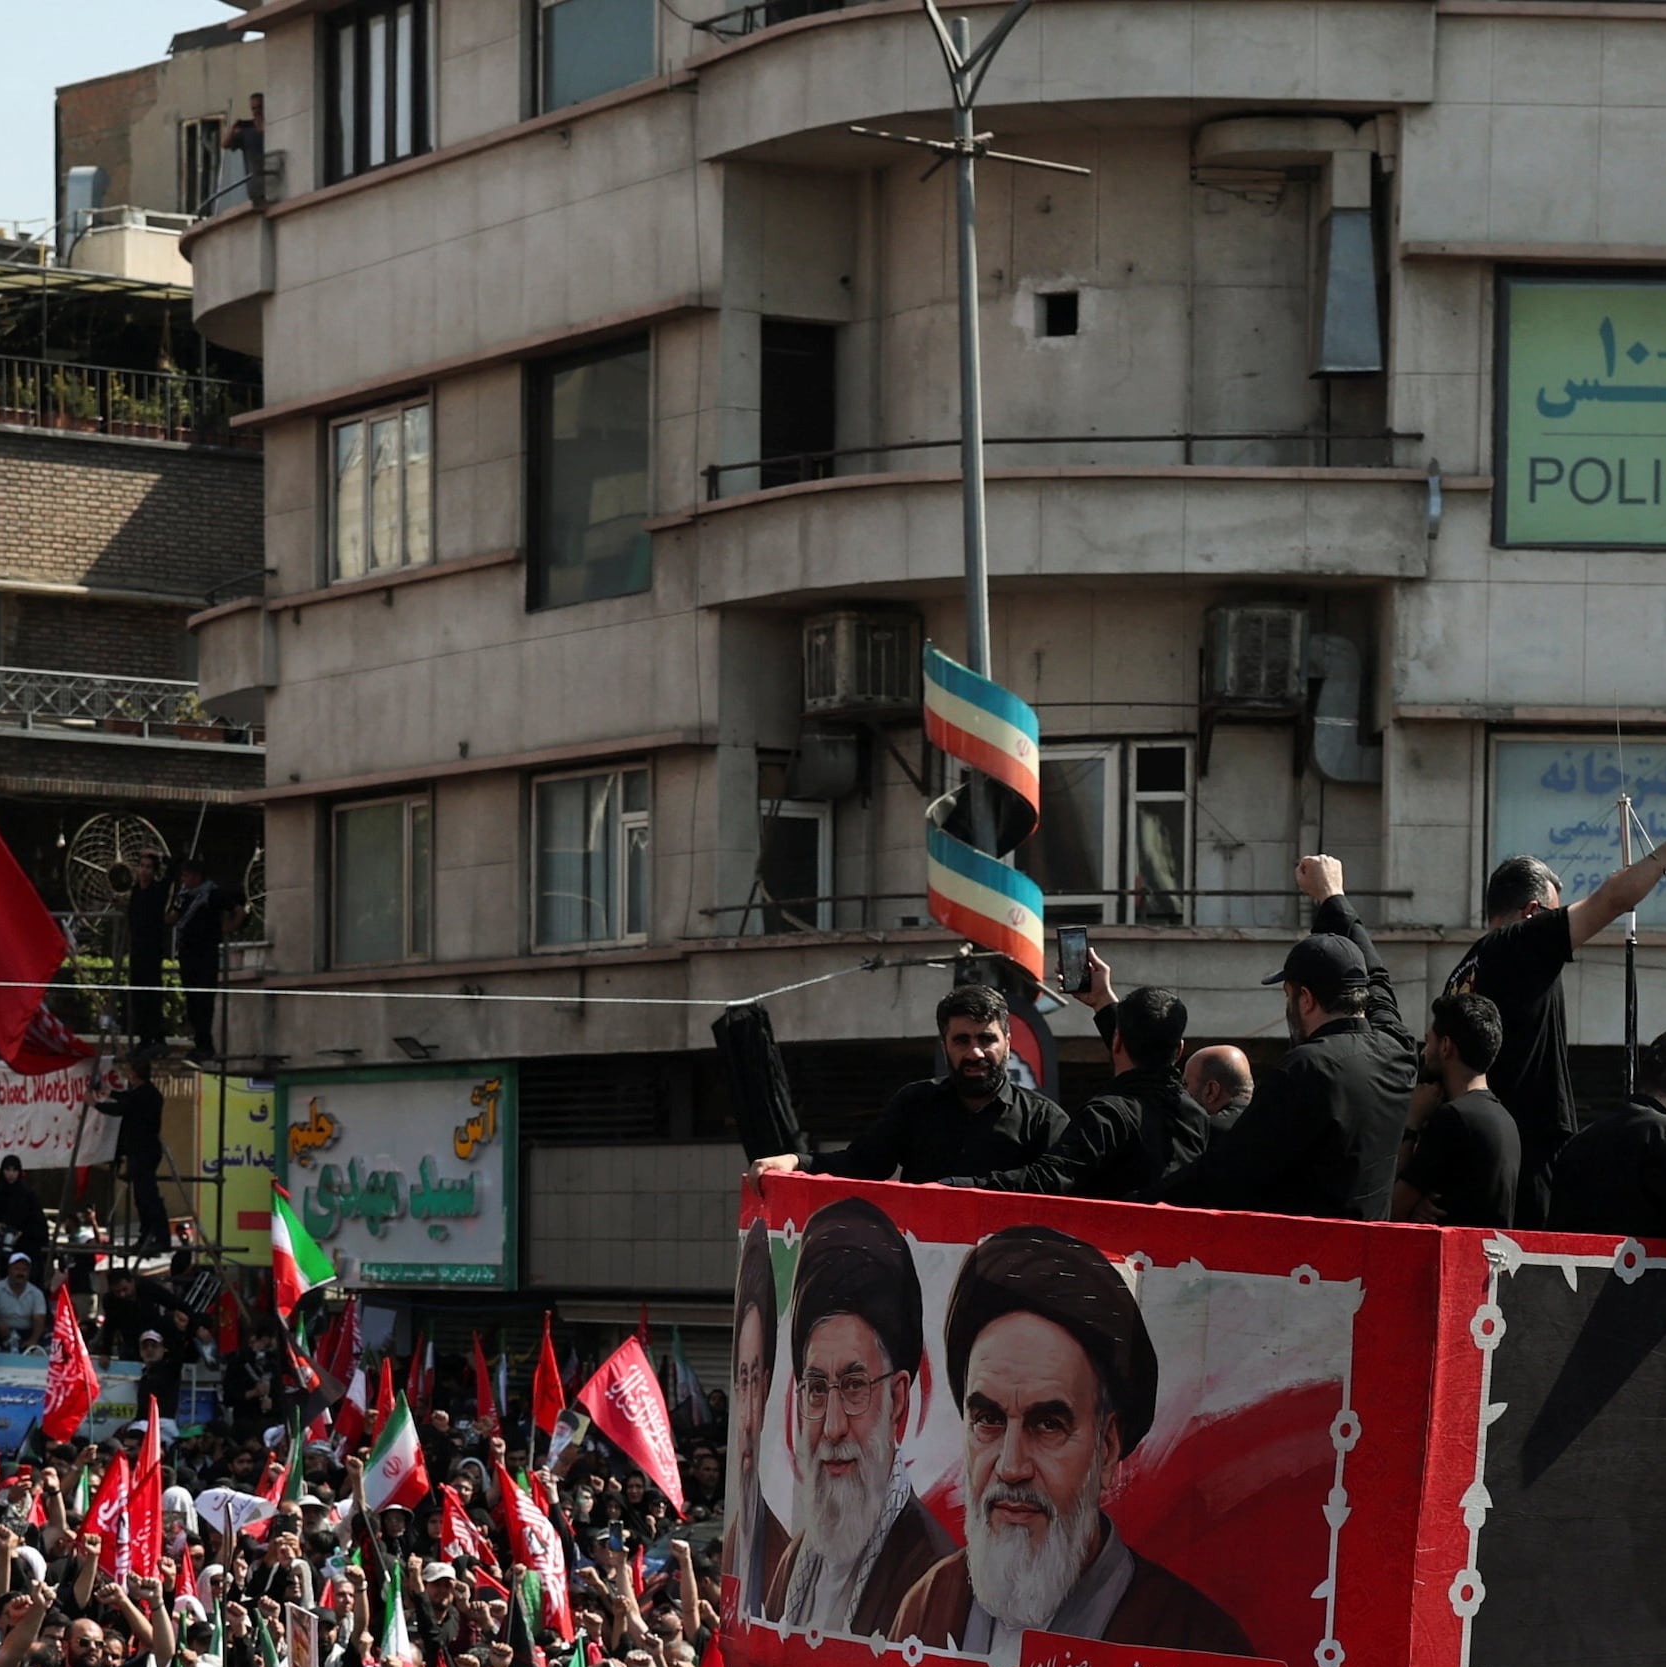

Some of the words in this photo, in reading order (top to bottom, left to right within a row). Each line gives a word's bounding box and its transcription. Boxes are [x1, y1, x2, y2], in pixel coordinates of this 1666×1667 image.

[1548, 818, 1623, 846] رسمی
[288, 1096, 338, 1168] حلیم
[454, 1078, 501, 1160] آش
[202, 1145, 275, 1173] هداشتی
[304, 1154, 403, 1240] مهدی
[410, 1154, 480, 1241] سید
